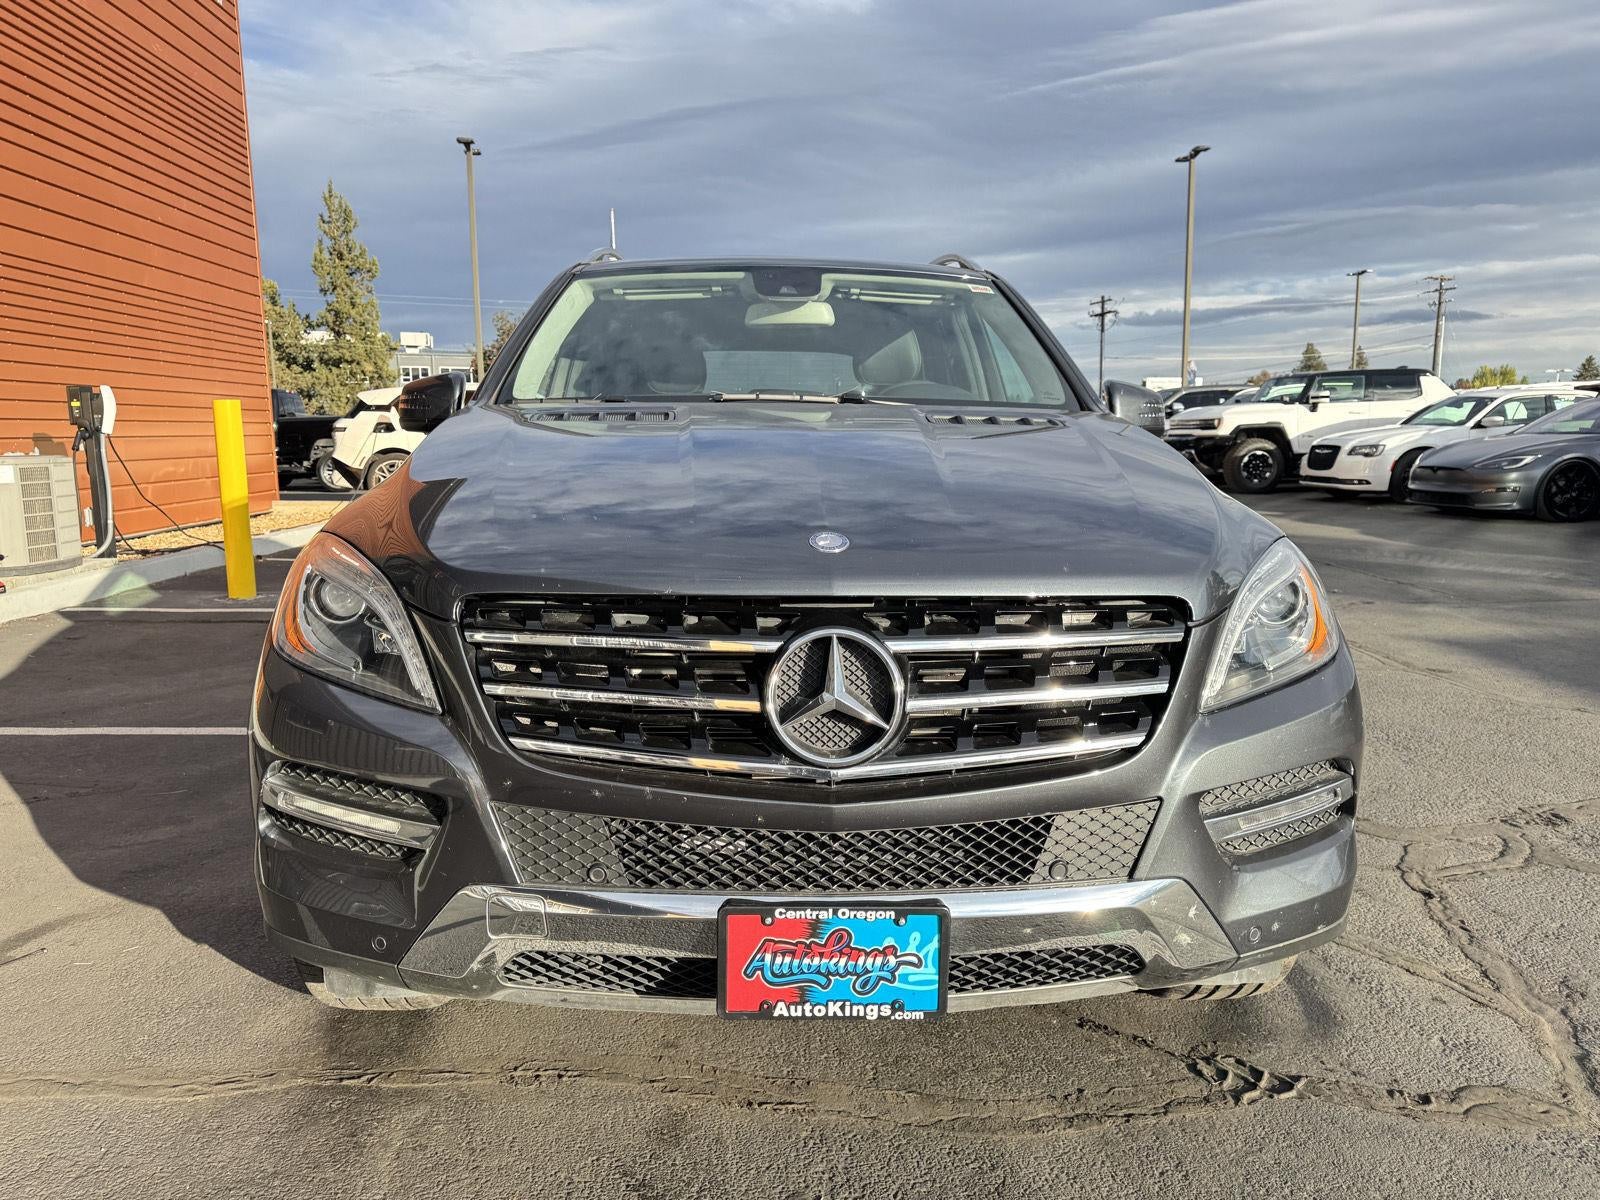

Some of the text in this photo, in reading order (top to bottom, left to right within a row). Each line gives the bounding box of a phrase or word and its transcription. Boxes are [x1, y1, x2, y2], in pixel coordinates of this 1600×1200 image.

[774, 908, 896, 921] Central Oregon
[772, 1002, 924, 1020] AutoKings.com
